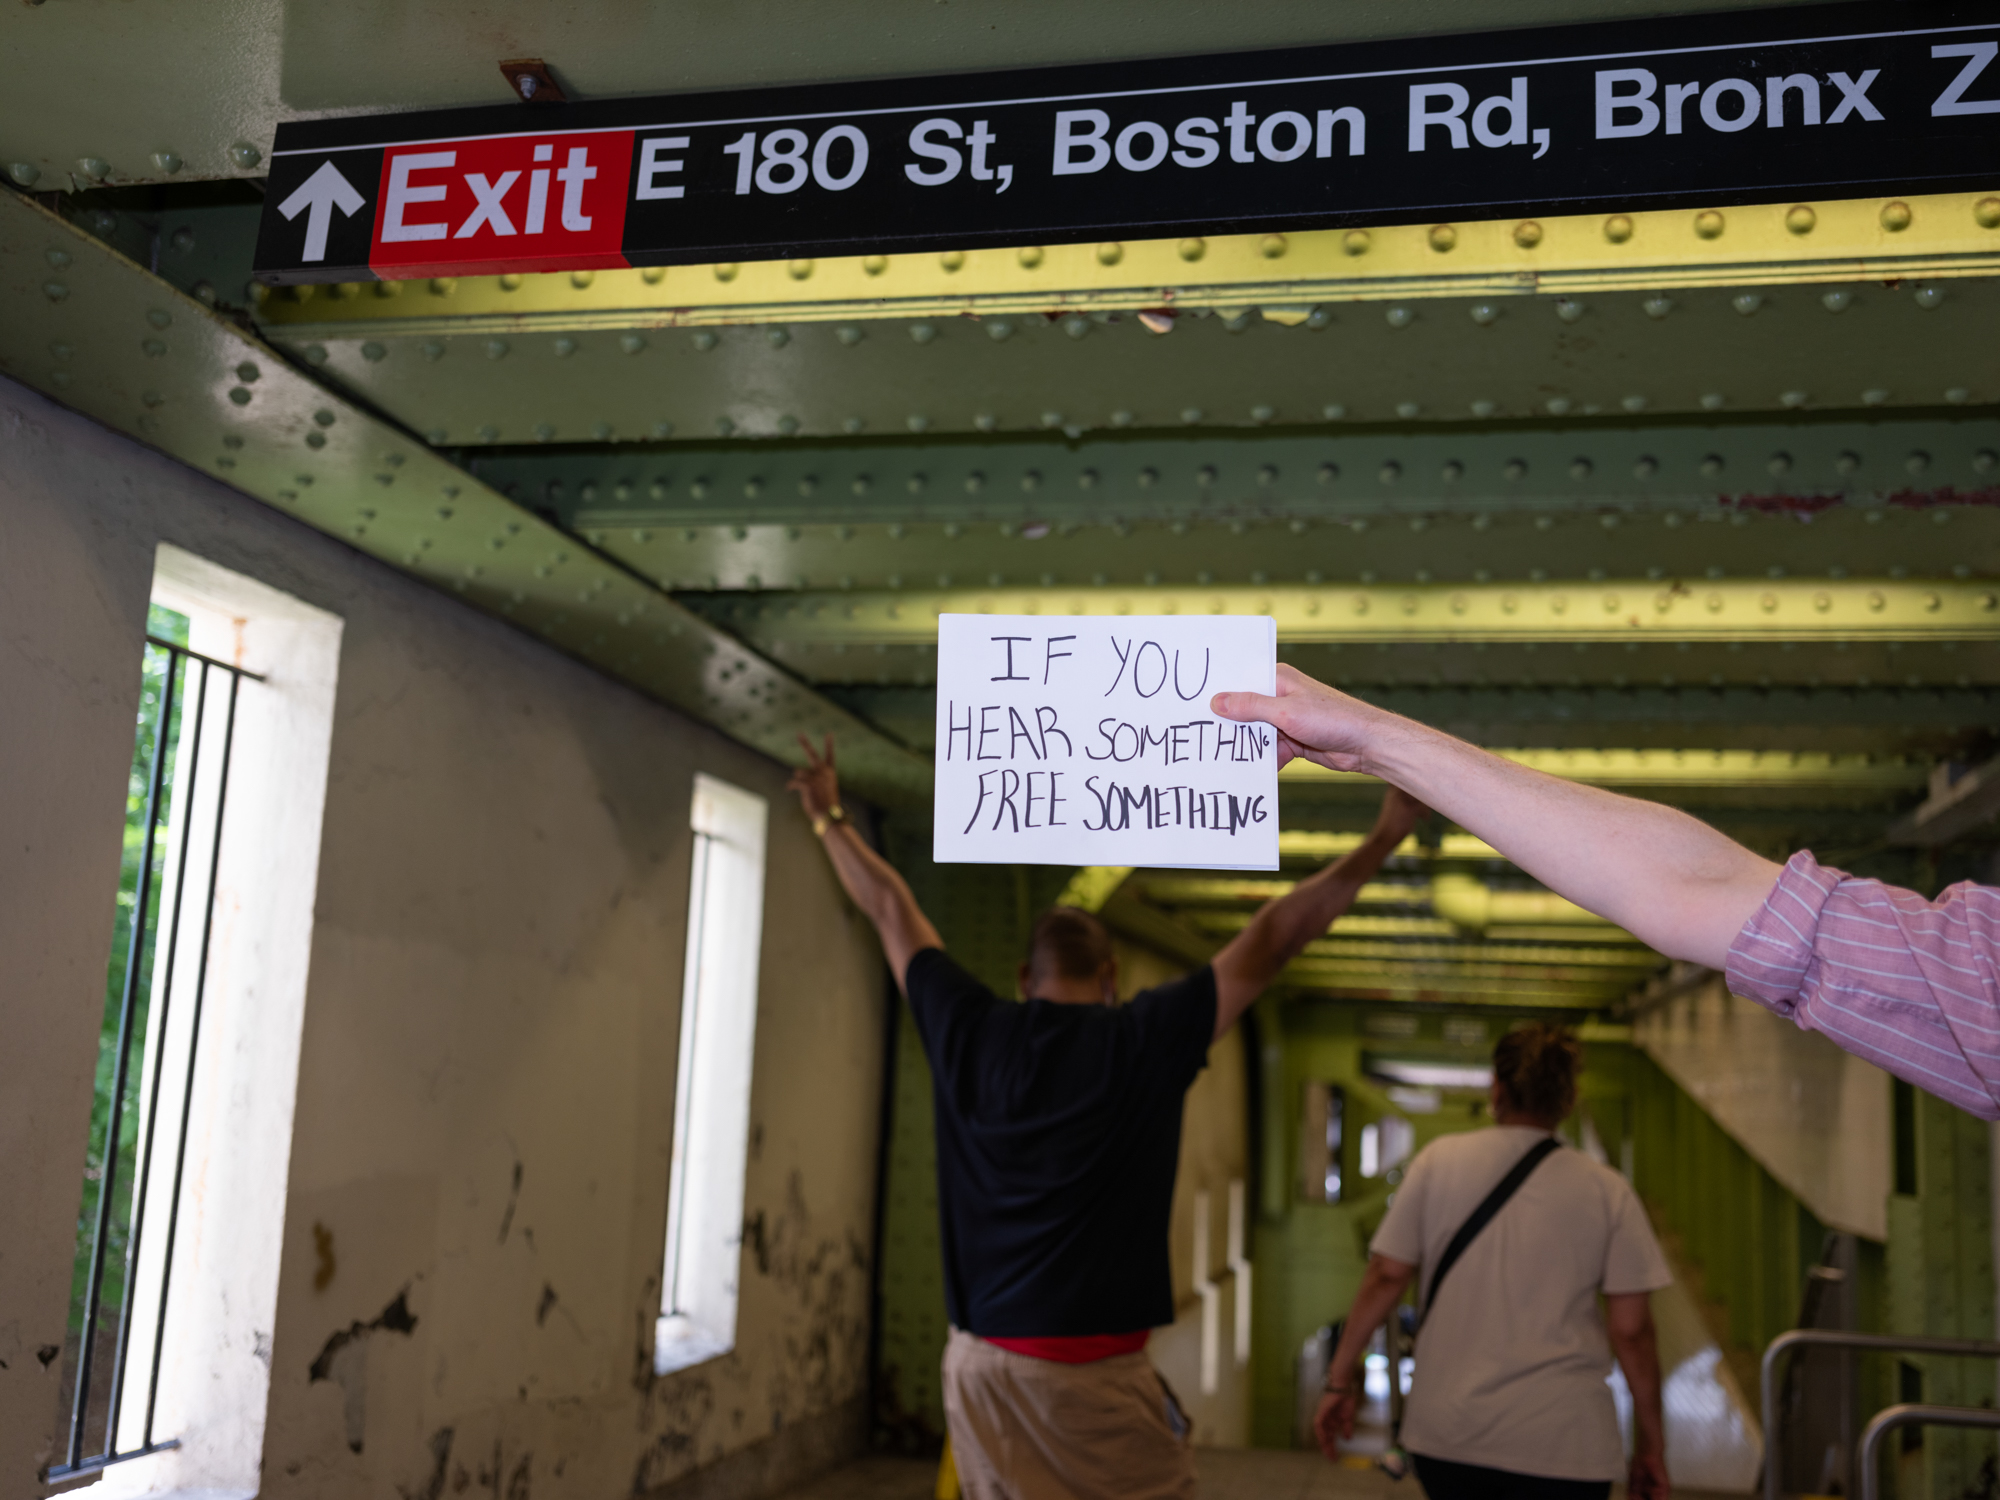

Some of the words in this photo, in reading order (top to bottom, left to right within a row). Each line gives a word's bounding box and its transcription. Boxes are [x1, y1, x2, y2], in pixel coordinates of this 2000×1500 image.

[380, 144, 598, 243] Exit
[635, 136, 690, 201] E
[723, 125, 869, 195] 180
[904, 118, 1013, 194] St,
[1052, 101, 1366, 176] Boston
[1408, 76, 1550, 160] Rd,
[1595, 68, 1885, 140] Bronx
[1931, 41, 2000, 117] Z
[990, 635, 1077, 686] IF
[1104, 635, 1210, 702] YOU
[946, 699, 1073, 762] HEAR
[1084, 717, 1270, 767] SOMETHING
[963, 768, 1067, 835] FREE
[1082, 775, 1268, 837] SOMETHING
